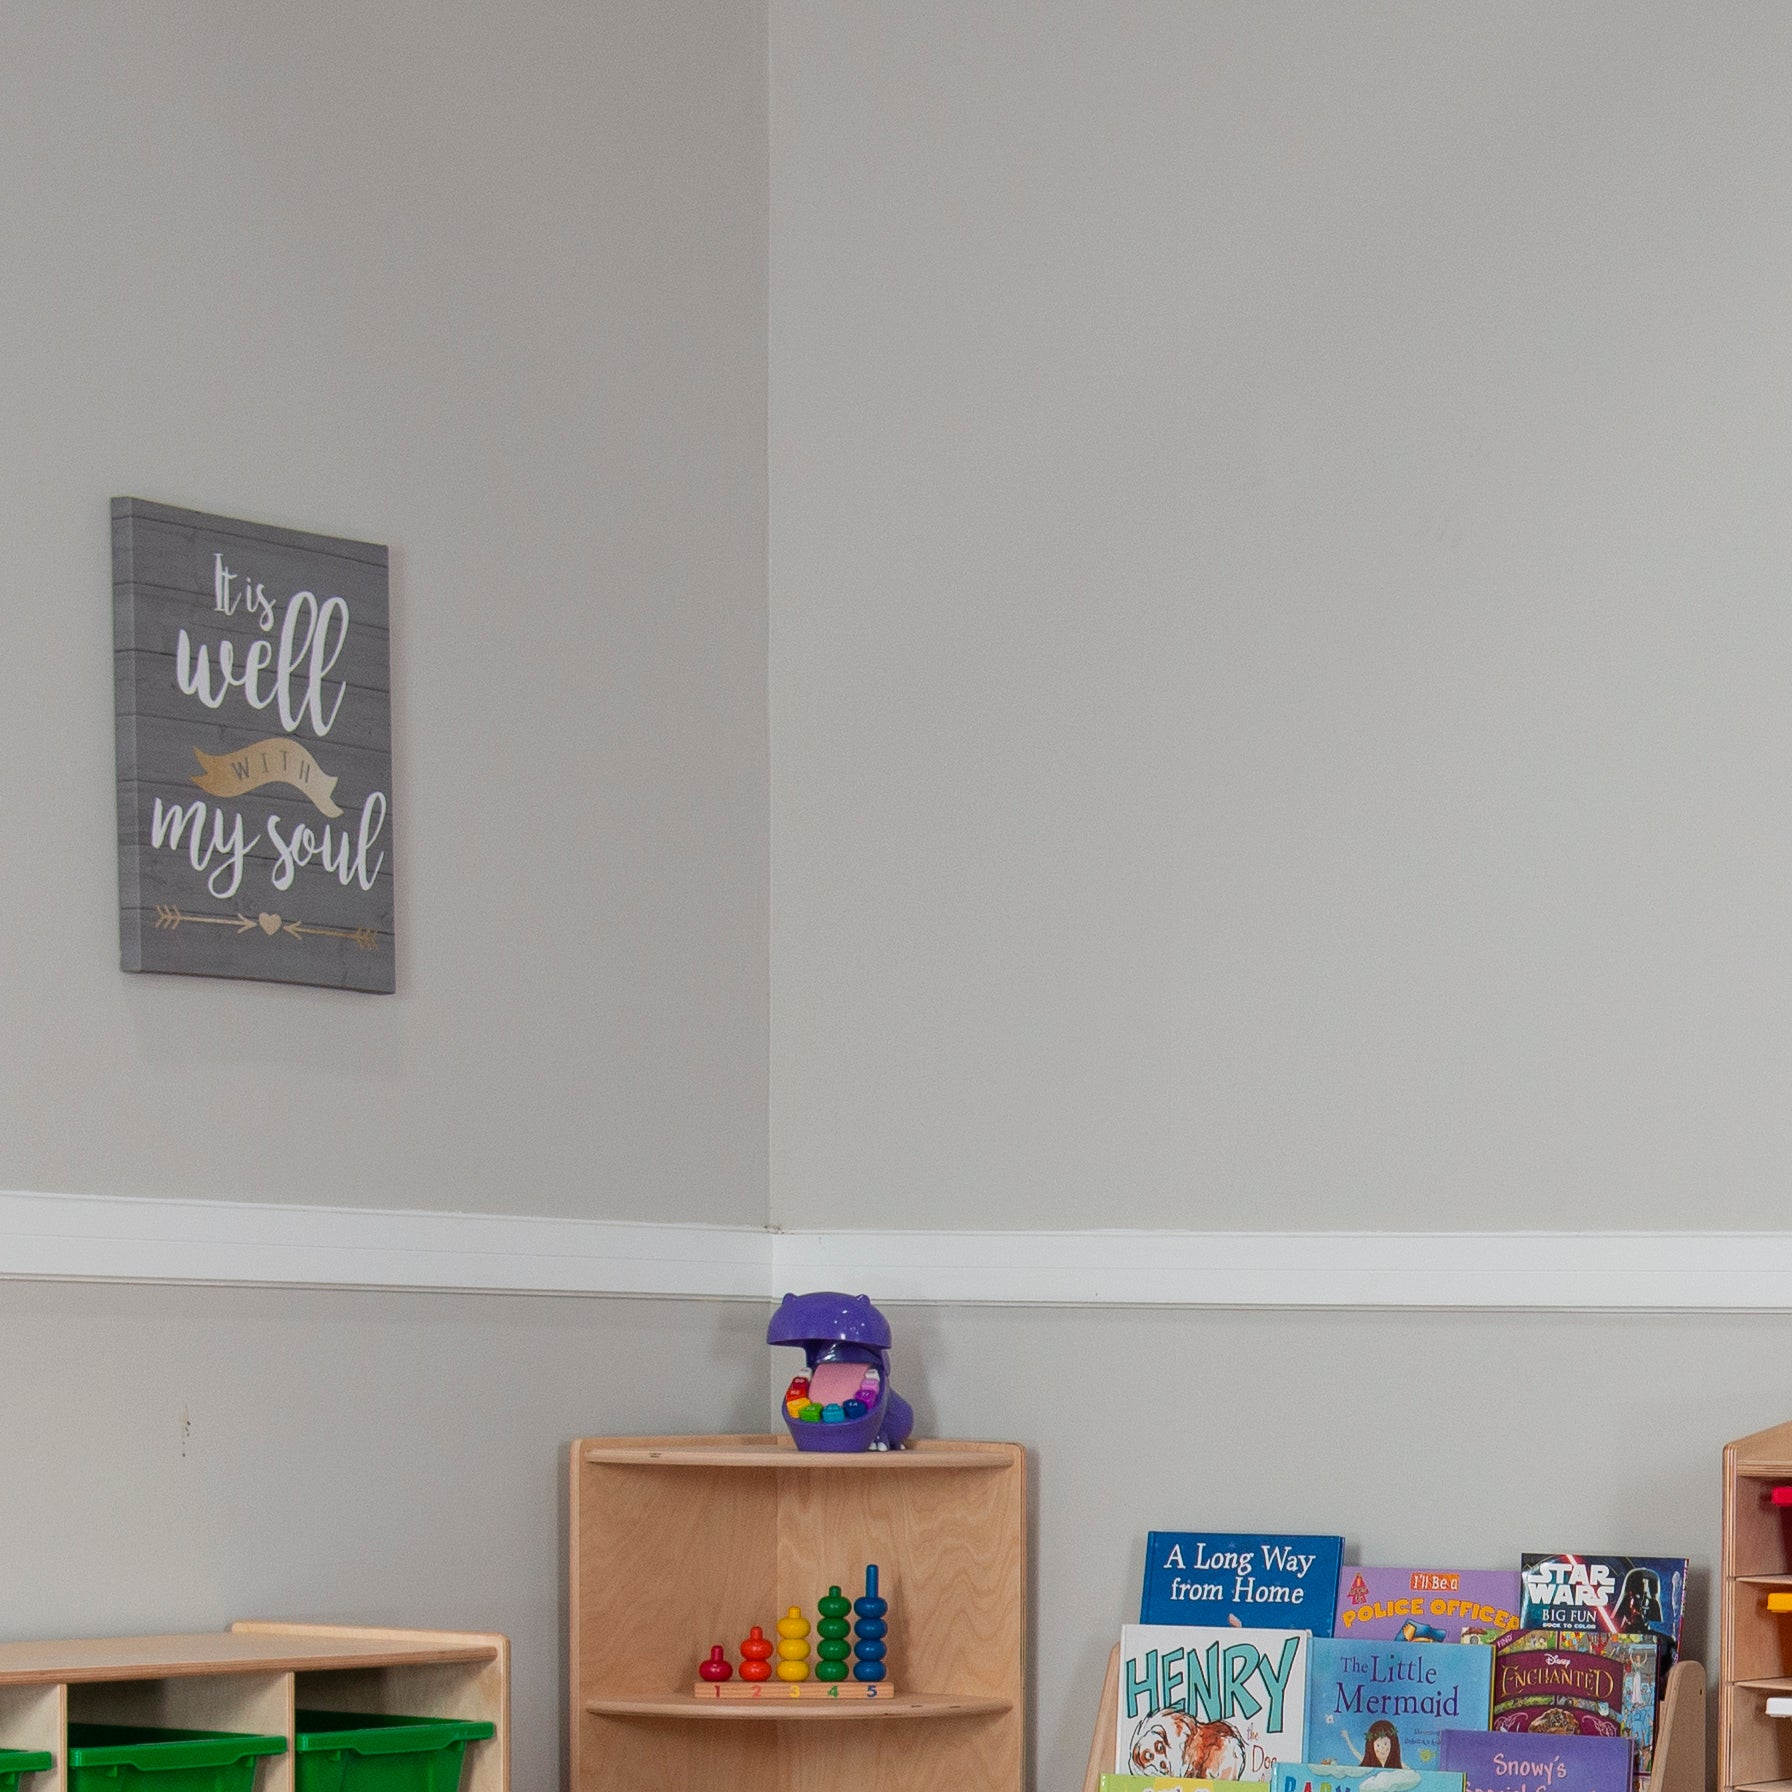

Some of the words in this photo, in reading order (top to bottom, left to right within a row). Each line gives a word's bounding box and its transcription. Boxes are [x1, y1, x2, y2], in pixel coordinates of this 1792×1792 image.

[213, 552, 237, 616] It
[245, 577, 276, 631] is
[176, 590, 349, 737] well
[231, 749, 311, 784] WITH
[151, 797, 261, 899] my
[266, 791, 387, 892] soul
[1163, 1544, 1186, 1569] A
[1194, 1543, 1254, 1576] Long
[1261, 1545, 1316, 1578] Way
[1413, 1574, 1429, 1590] I'll
[1432, 1575, 1448, 1590] Be
[1450, 1579, 1458, 1590] a
[1528, 1562, 1615, 1585] STAR
[1170, 1577, 1223, 1601] from
[1232, 1577, 1304, 1604] Home
[1528, 1583, 1615, 1606] WARS
[1342, 1597, 1425, 1629] POLICE
[1542, 1609, 1566, 1621] BIG
[1570, 1610, 1597, 1623] FUN
[1496, 1634, 1513, 1648] FIND
[1340, 1656, 1368, 1674] The
[1370, 1654, 1437, 1684] Little
[1544, 1653, 1571, 1668] Disney
[714, 1685, 721, 1698] 1
[751, 1685, 762, 1698] 2
[789, 1684, 800, 1698] 3
[827, 1685, 839, 1698] 4
[866, 1685, 878, 1698] 5
[1126, 1636, 1301, 1733] HENRY
[1500, 1664, 1615, 1699] ENCHANTED
[1334, 1681, 1459, 1718] Mermaid
[1246, 1723, 1260, 1742] the
[1493, 1752, 1568, 1786] Snowy's
